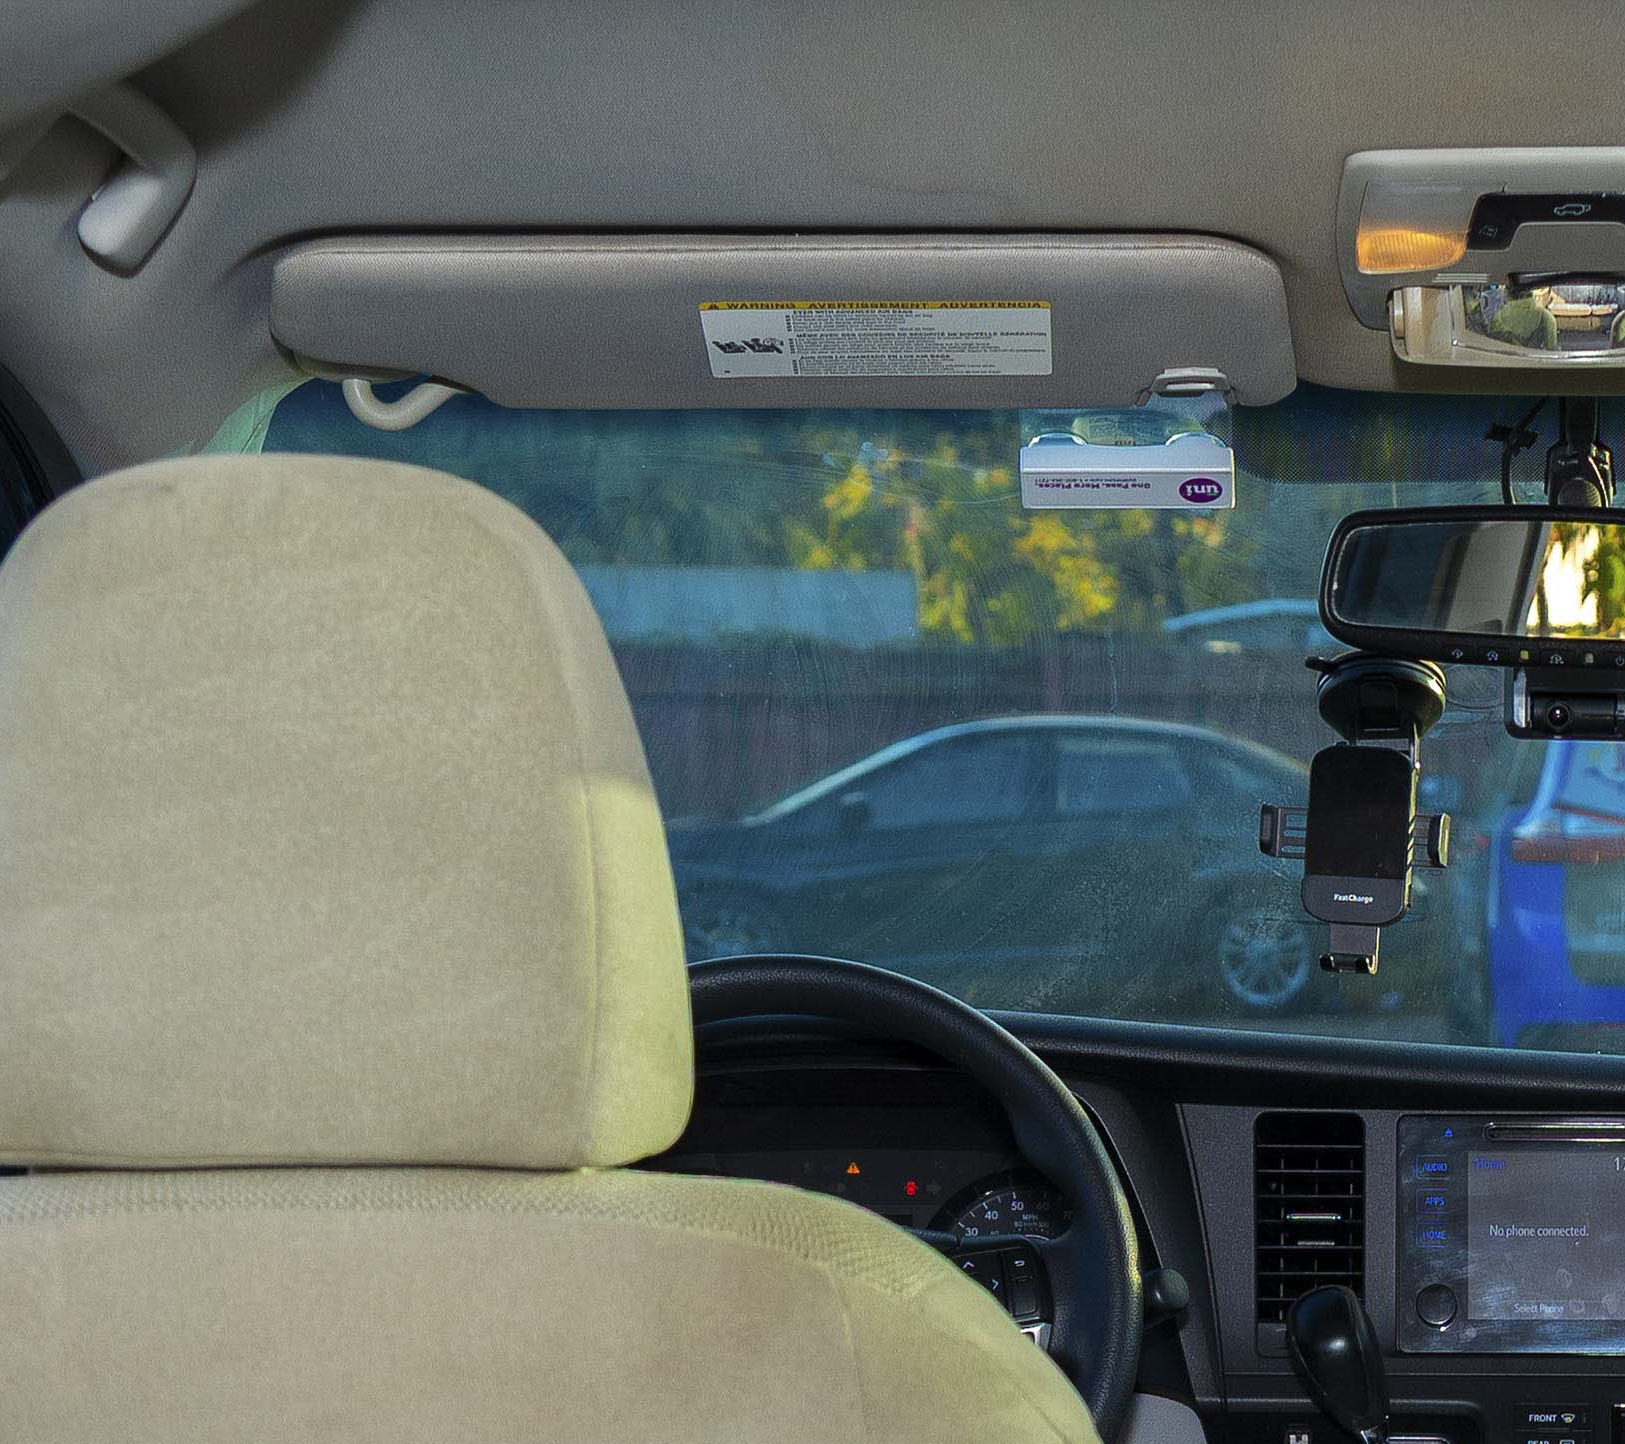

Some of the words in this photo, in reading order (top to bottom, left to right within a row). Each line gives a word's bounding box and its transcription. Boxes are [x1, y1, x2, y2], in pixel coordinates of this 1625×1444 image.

[727, 302, 796, 310] WARNING
[808, 302, 930, 310] AVERTISSEMENT
[940, 301, 1042, 309] ADVERTENCIA
[1185, 483, 1220, 497] uni
[1333, 893, 1374, 905] FastCharge
[1422, 1162, 1448, 1173] AUDIO
[1010, 1201, 1024, 1211] 50
[1424, 1196, 1445, 1207] APPS
[984, 1210, 999, 1220] 40
[964, 1226, 979, 1237] 30
[1422, 1230, 1448, 1240] HOME
[1489, 1224, 1505, 1237] No
[1505, 1224, 1536, 1239] phone
[1537, 1224, 1589, 1237] connected.
[1514, 1303, 1538, 1314] Select
[1528, 1413, 1557, 1424] FRONT
